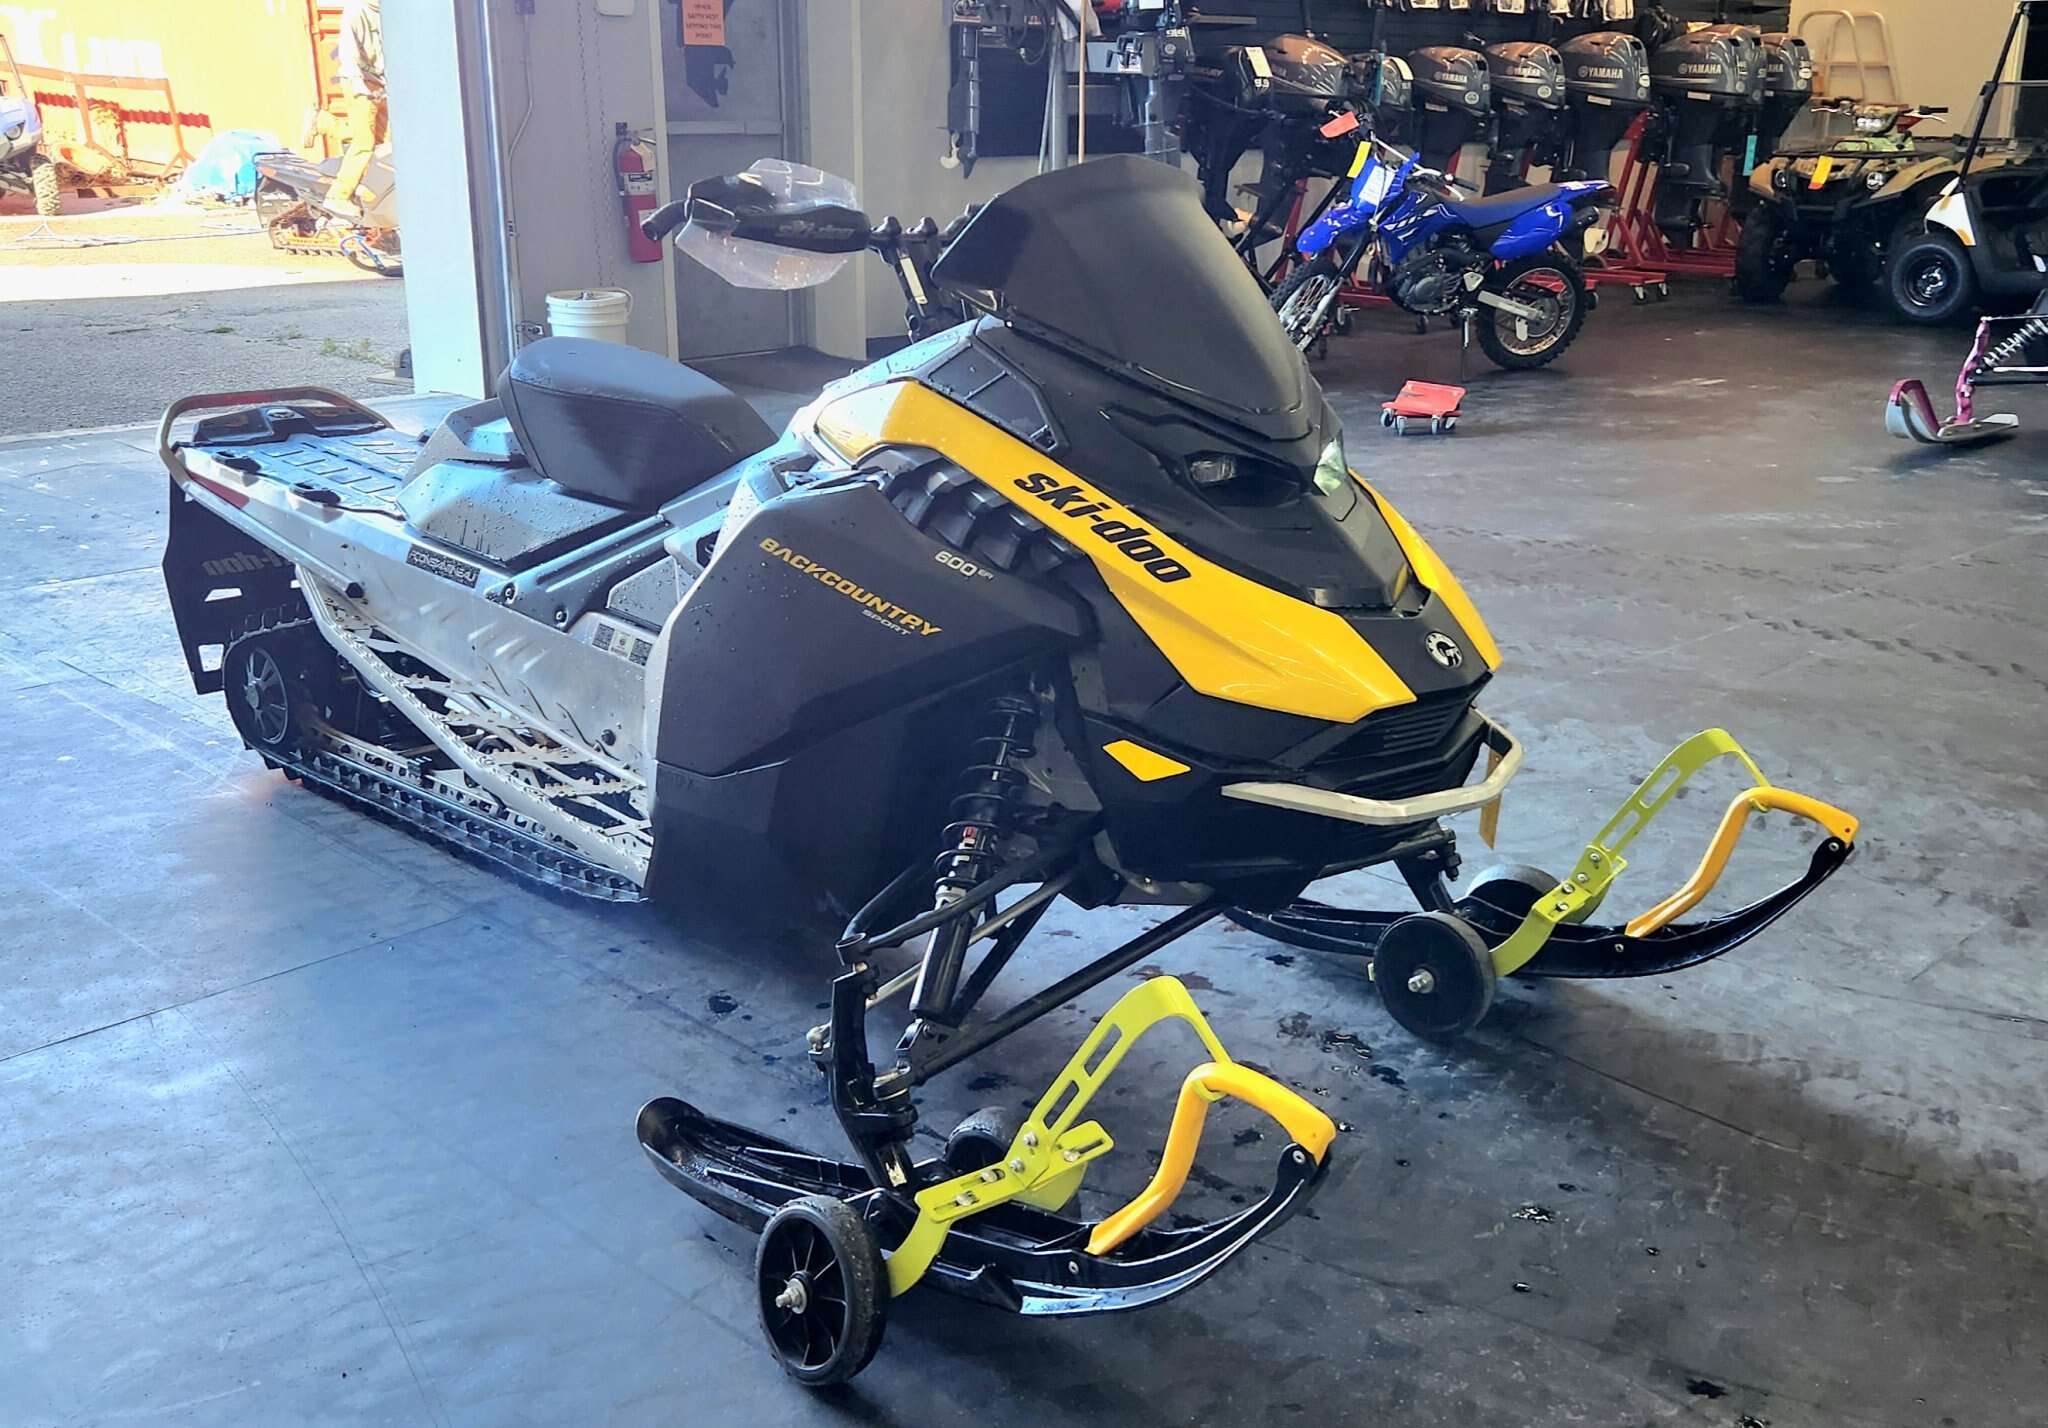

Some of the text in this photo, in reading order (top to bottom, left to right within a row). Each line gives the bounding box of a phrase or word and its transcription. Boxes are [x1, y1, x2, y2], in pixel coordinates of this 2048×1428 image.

[1512, 66, 1541, 78] YAMAHA
[1588, 67, 1624, 79] YAMAHA
[1688, 63, 1722, 75] YAMAHA
[1440, 72, 1468, 84] YAMAHA
[934, 550, 978, 577] 600
[759, 537, 943, 636] BACKCOUNTRY
[861, 608, 912, 636] SPORT
